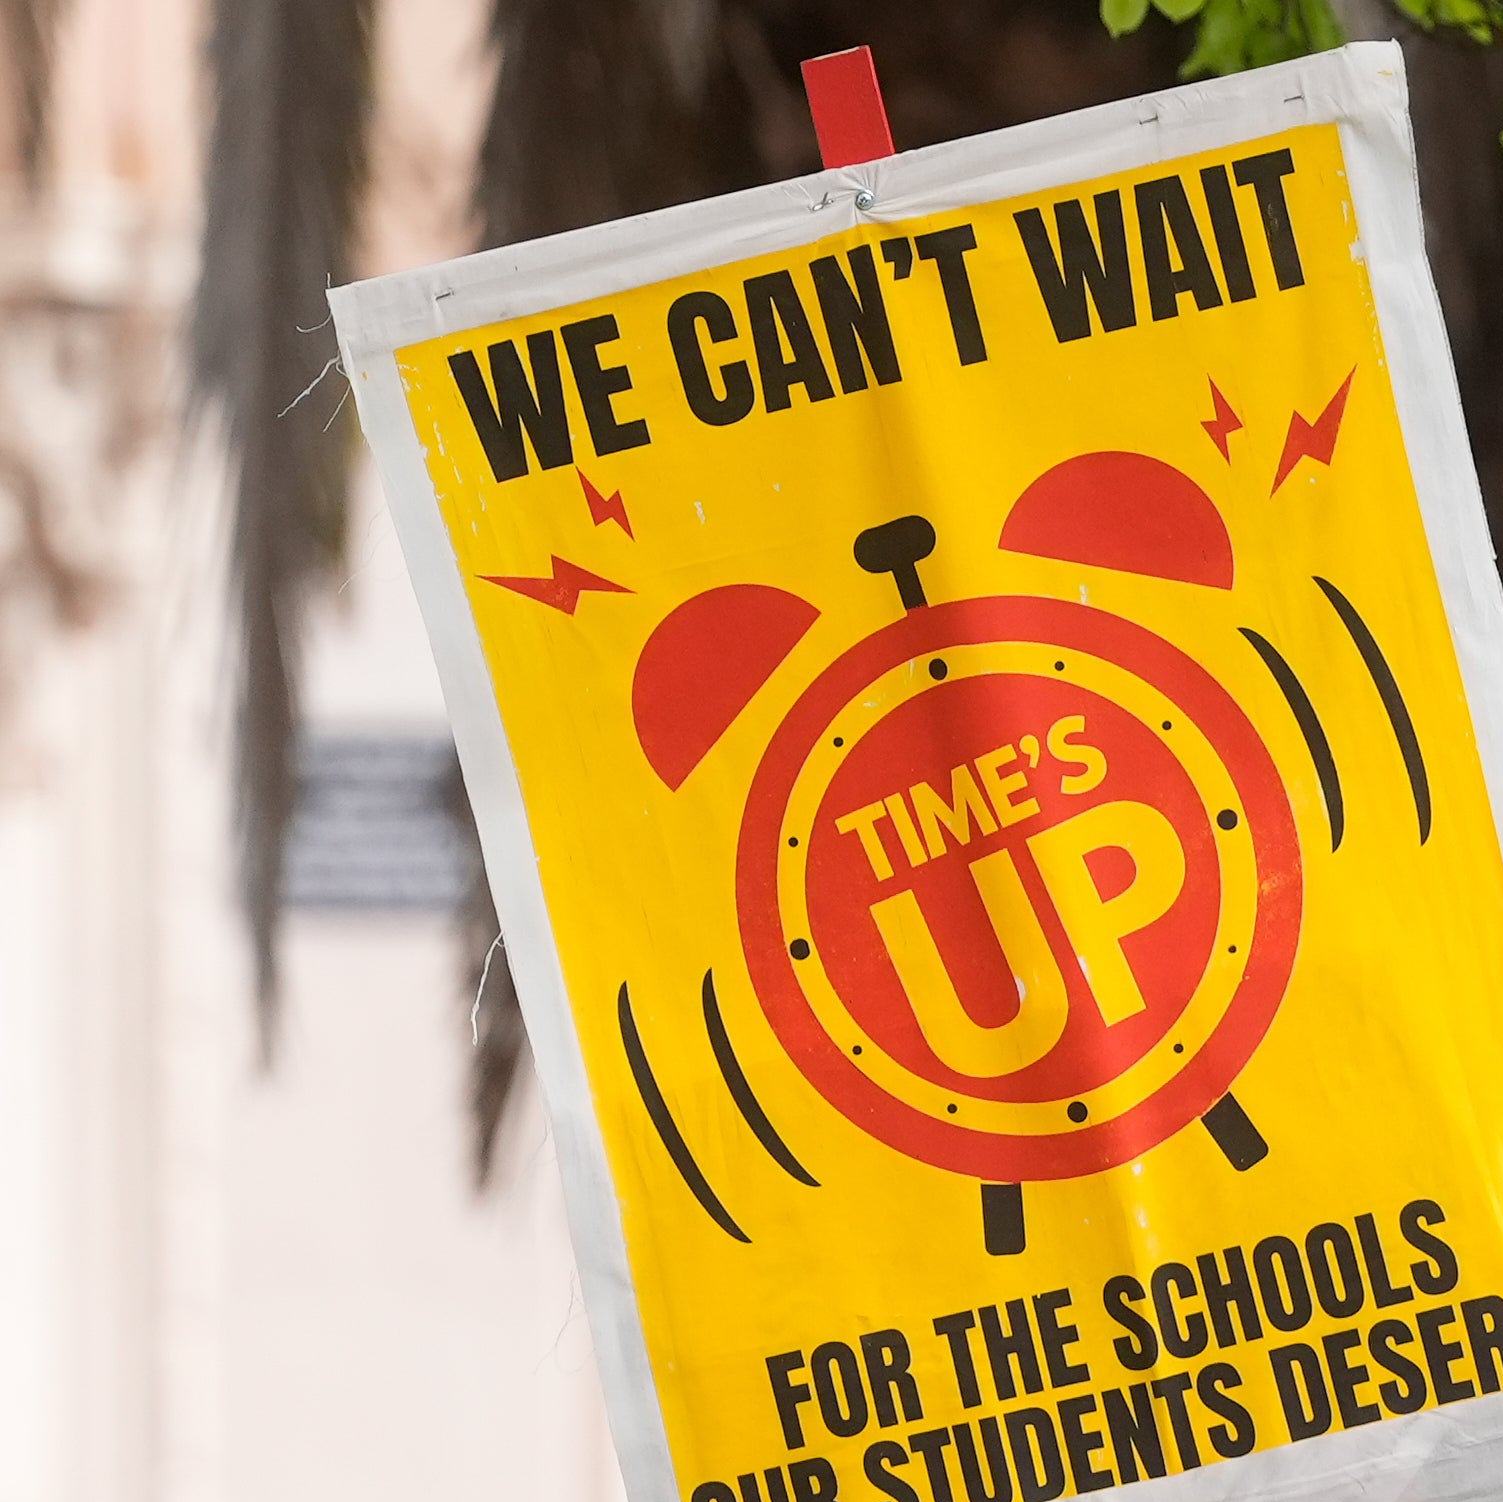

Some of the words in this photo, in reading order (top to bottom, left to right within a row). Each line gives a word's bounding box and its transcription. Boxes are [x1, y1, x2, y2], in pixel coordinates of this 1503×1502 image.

[449, 317, 652, 483] WE
[666, 225, 987, 426] CAN'T
[1013, 148, 1306, 343] WAIT
[834, 715, 1108, 882] TIME'S
[869, 800, 1186, 1078] UP
[764, 1327, 923, 1449] FOR
[933, 1287, 1090, 1408] THE
[1103, 1199, 1460, 1371] SCHOOLS
